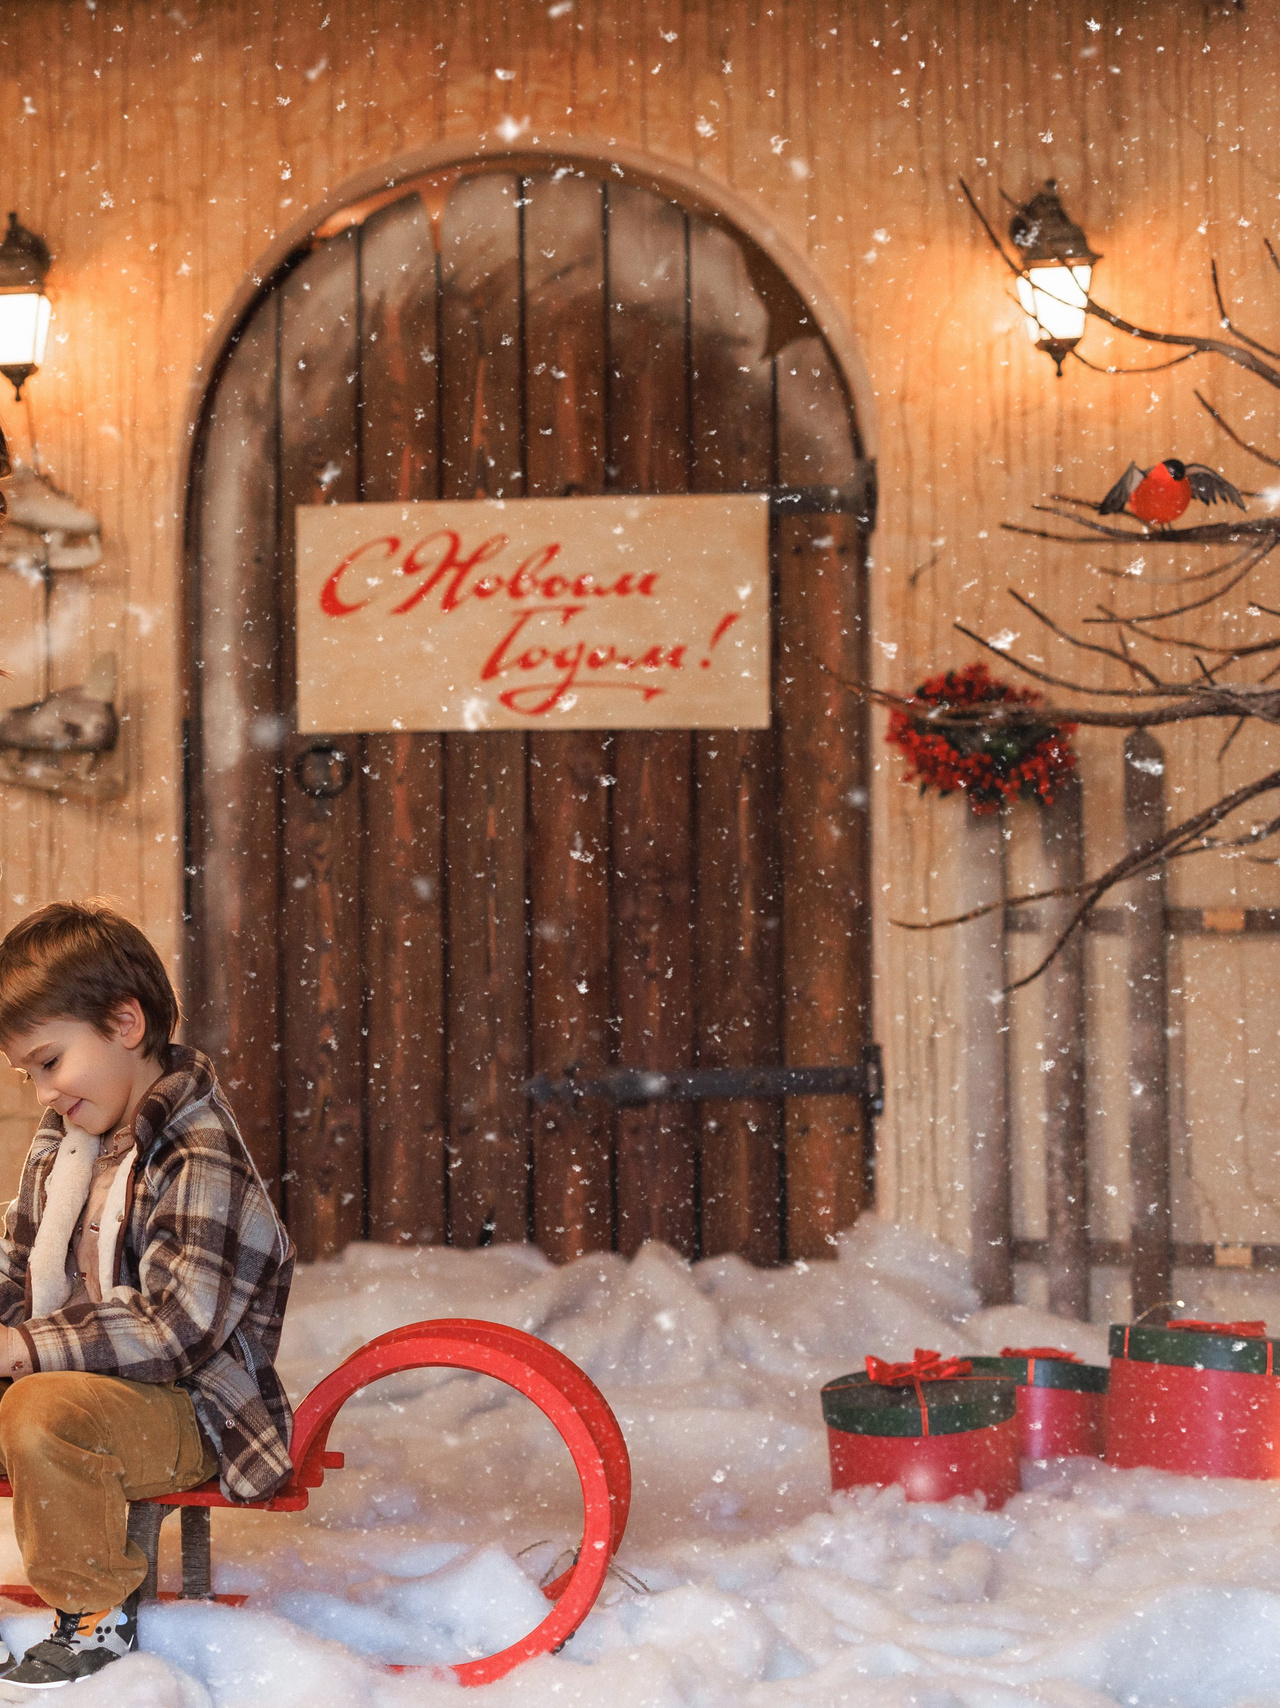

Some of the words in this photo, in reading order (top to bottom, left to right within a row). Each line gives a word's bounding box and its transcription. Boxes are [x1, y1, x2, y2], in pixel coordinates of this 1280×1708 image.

[321, 536, 401, 617] С
[390, 530, 659, 615] Новым
[481, 605, 740, 716] Годом!
